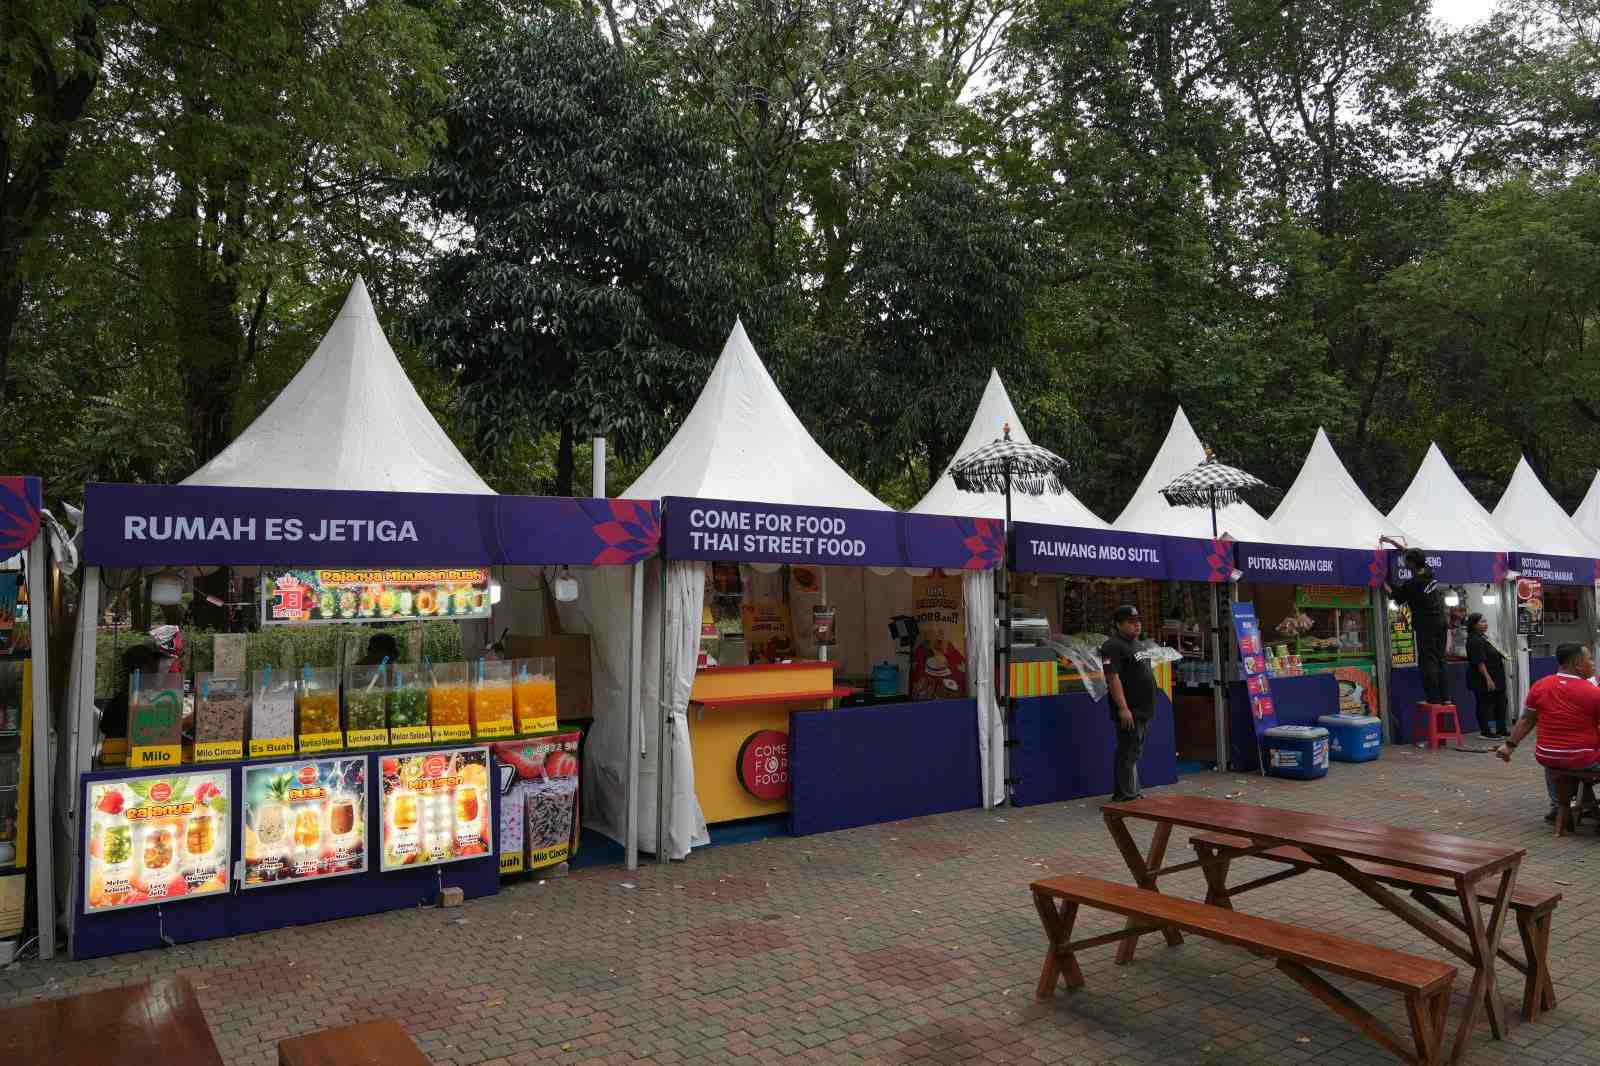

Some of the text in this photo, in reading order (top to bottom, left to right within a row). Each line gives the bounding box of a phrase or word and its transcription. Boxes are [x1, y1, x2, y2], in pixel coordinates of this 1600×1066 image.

[124, 516, 419, 542] RUMAH ES JETIGA
[690, 509, 847, 535] COME FOR FOOD
[690, 531, 866, 558] THAI STREET FOOD
[1030, 540, 1160, 563] TALIWANG MBO SUTIL
[1247, 556, 1334, 573] PUTRA SENAYAN GBK
[1521, 558, 1534, 569] ROTI
[196, 749, 213, 760] Milo
[251, 743, 293, 753] Es Buah
[755, 744, 787, 757] COME
[142, 751, 171, 762] Milo
[127, 803, 194, 819] Rajanya
[500, 857, 520, 867] uah
